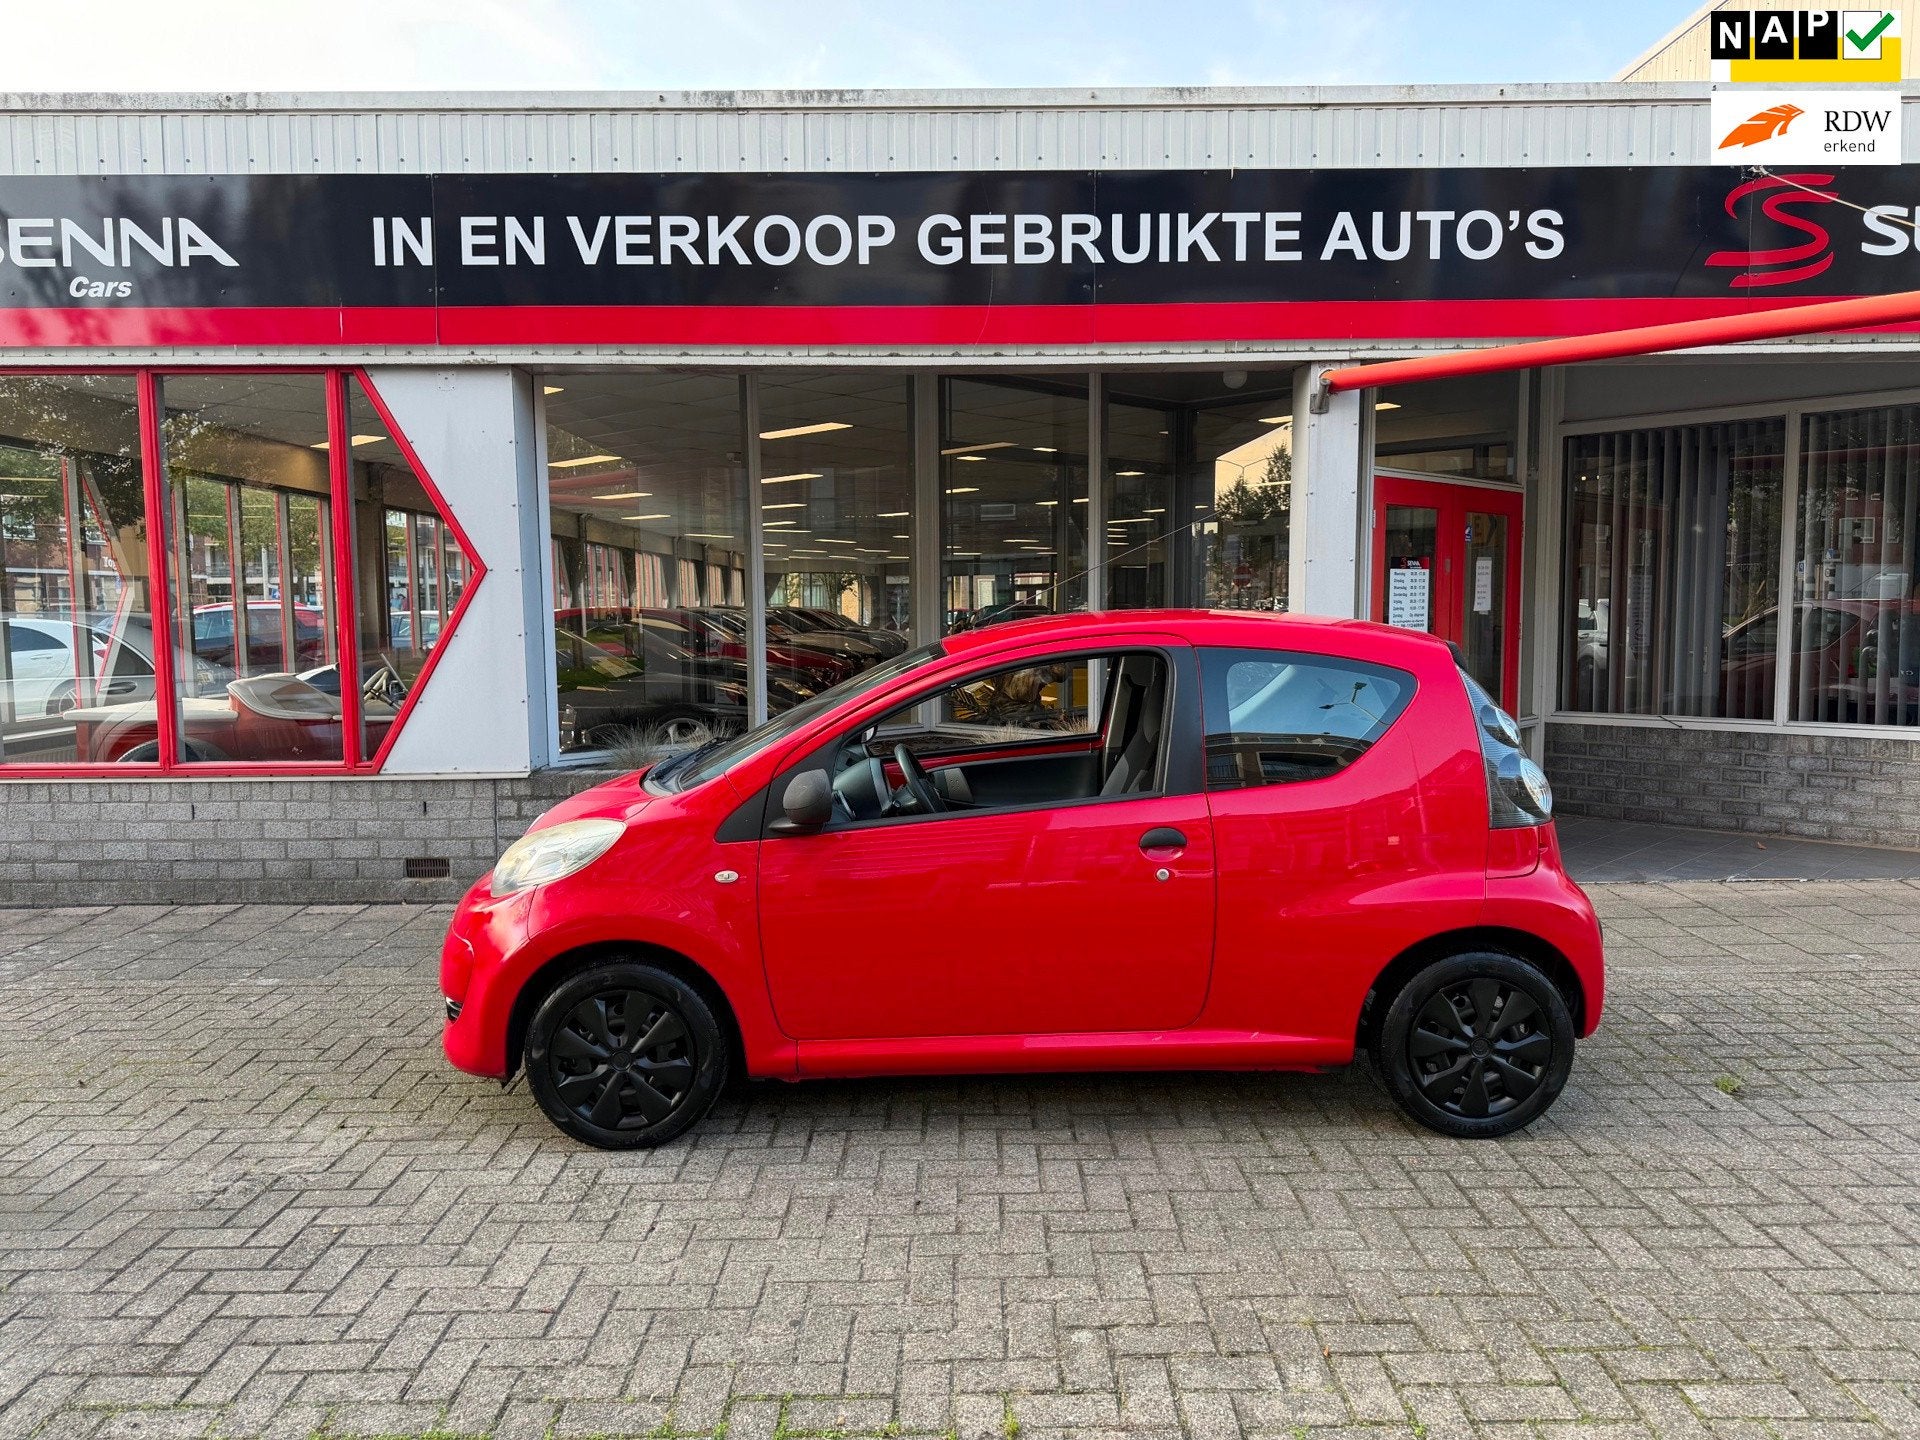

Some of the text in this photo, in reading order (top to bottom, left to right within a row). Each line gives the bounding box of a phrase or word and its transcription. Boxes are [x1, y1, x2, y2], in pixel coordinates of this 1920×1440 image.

[372, 209, 1566, 266] IN EN VERKOOP GEBRUIKTE AUTO'S
[1861, 205, 1920, 256] S
[69, 276, 133, 298] Cars
